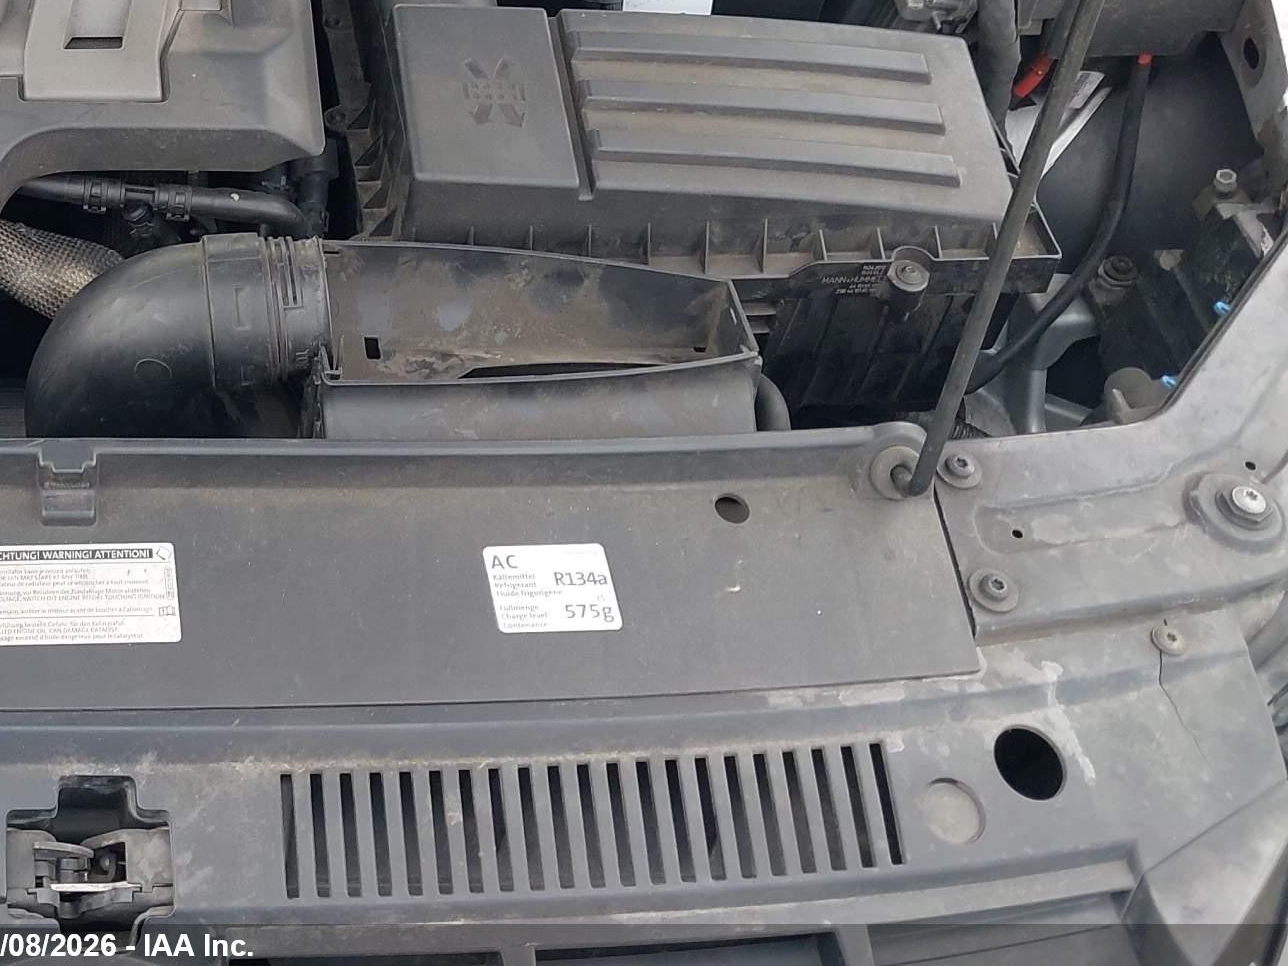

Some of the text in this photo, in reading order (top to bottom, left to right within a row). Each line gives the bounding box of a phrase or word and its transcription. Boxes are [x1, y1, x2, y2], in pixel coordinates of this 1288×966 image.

[40, 550, 92, 560] WARNING!
[95, 549, 150, 559] ATTENTION!
[492, 554, 519, 570] AC
[554, 571, 608, 587] R134a
[565, 604, 615, 623] 575g
